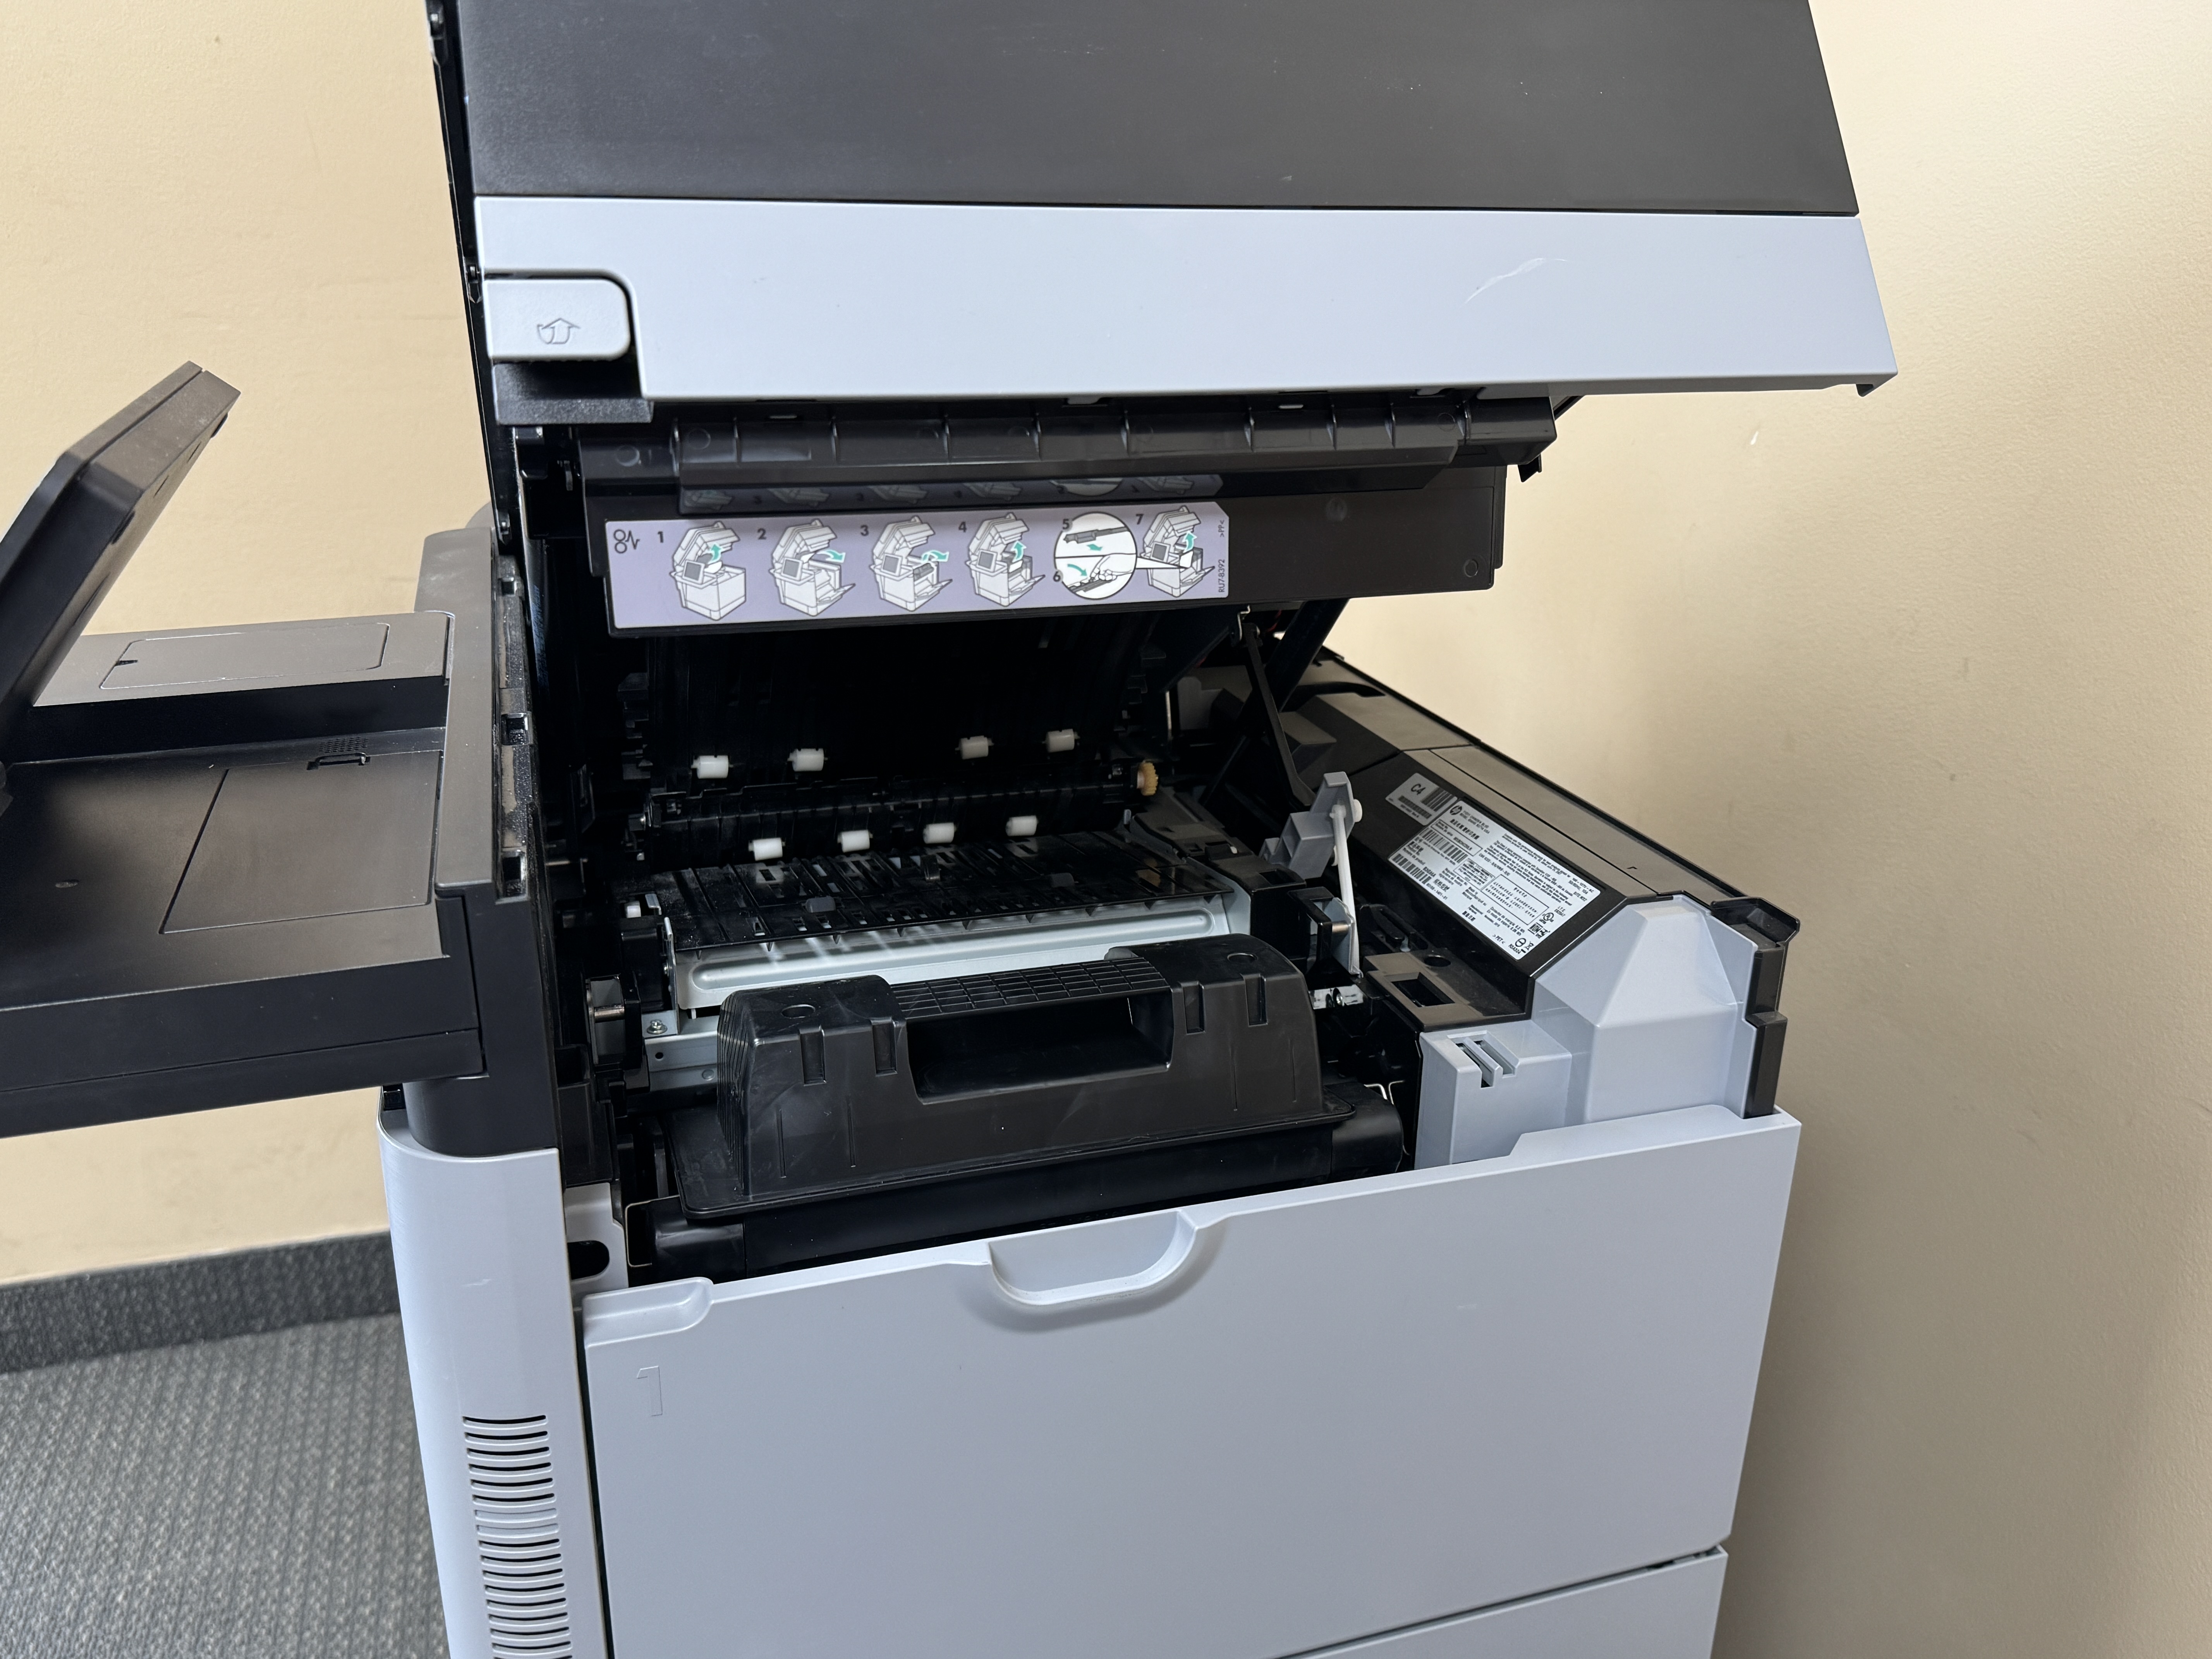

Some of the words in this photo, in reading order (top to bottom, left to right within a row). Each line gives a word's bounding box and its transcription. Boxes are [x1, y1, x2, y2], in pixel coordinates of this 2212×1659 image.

[1062, 518, 1070, 530] 5
[1135, 514, 1144, 525] 7
[860, 525, 869, 537] 3
[958, 521, 967, 533] 4
[657, 531, 664, 543] 1
[757, 528, 767, 540] 2
[1053, 570, 1061, 582] 6
[1411, 783, 1425, 795] C4
[636, 1365, 663, 1417] 1
